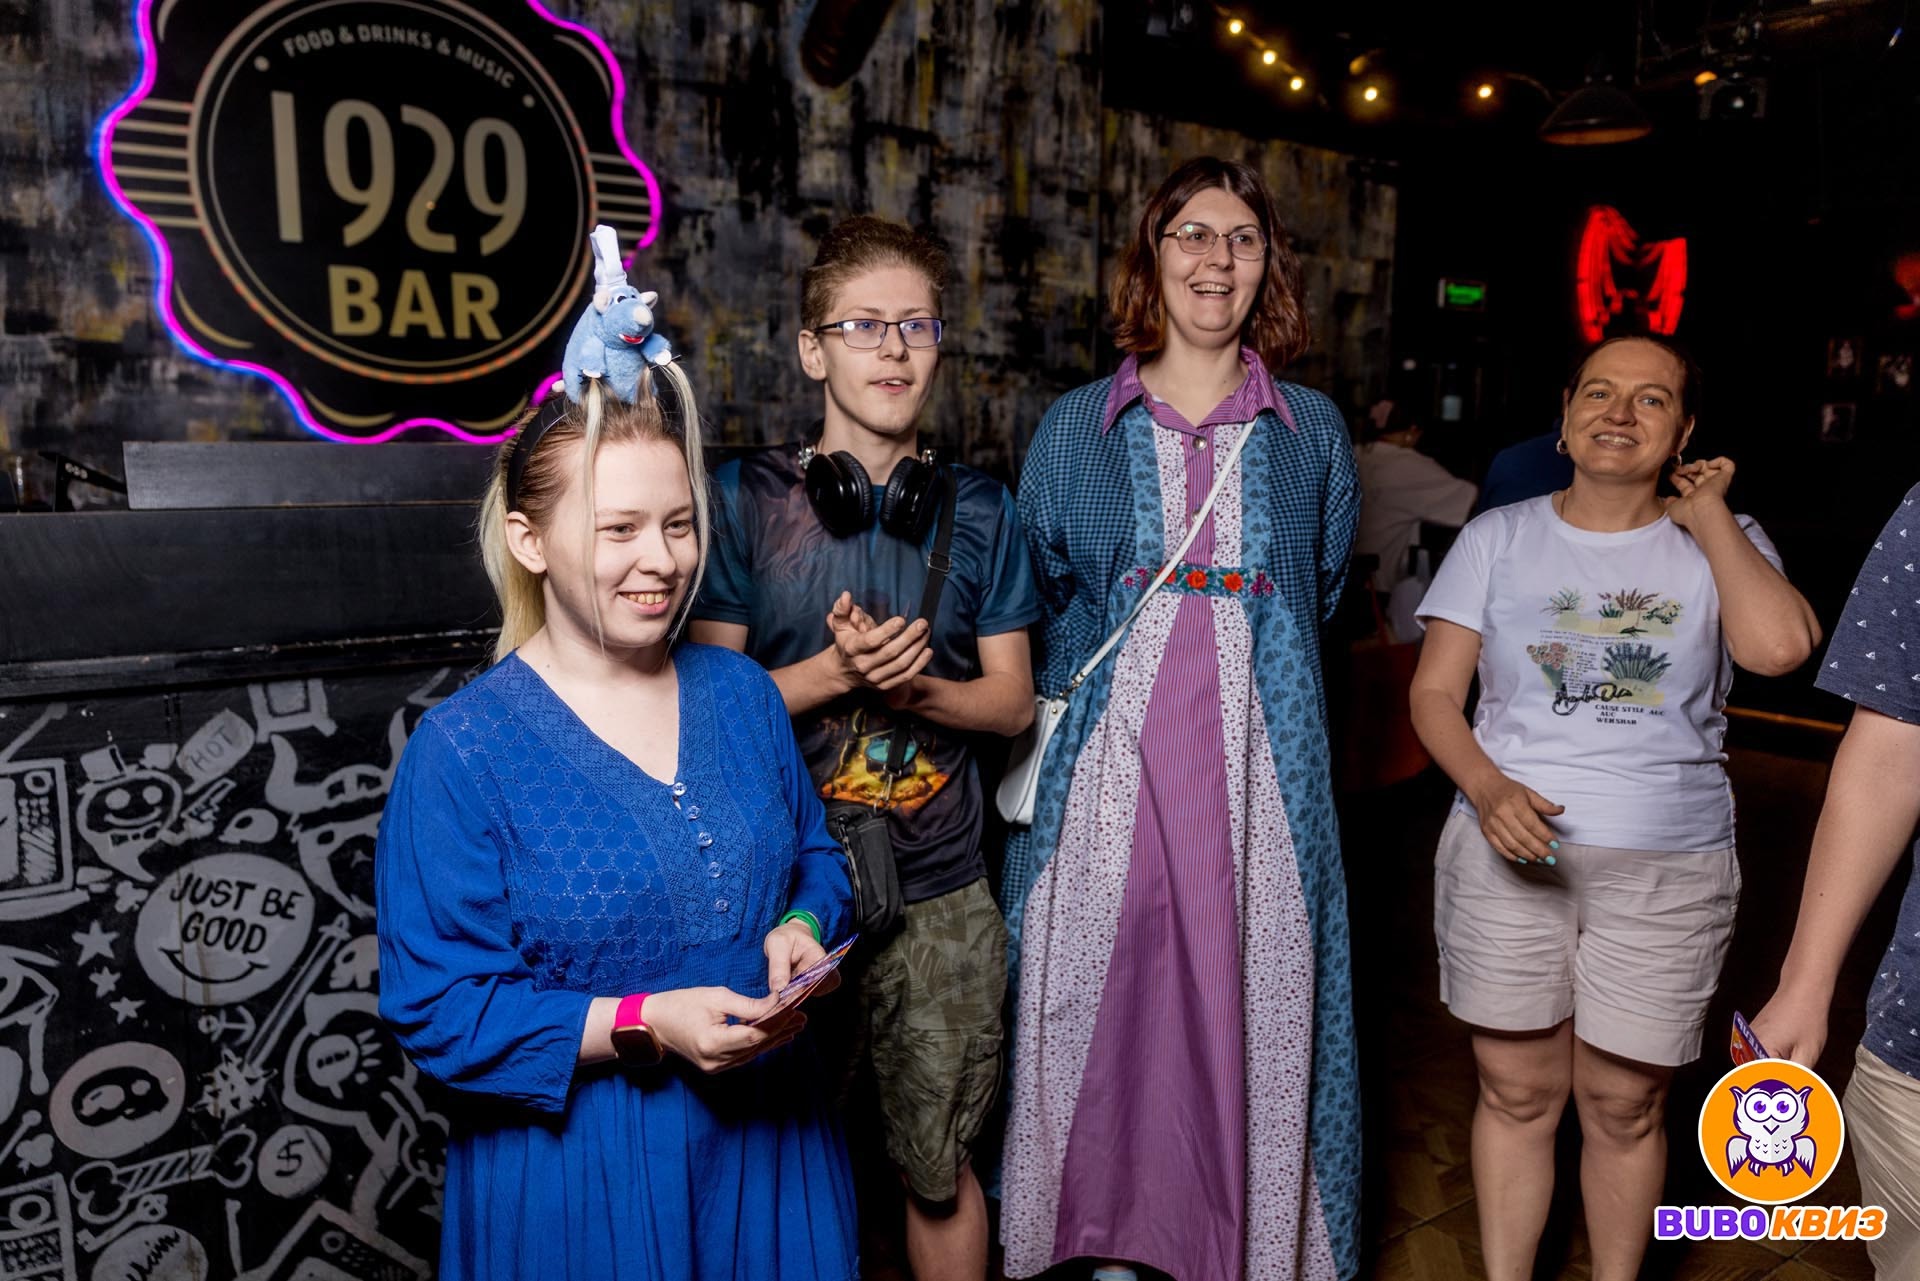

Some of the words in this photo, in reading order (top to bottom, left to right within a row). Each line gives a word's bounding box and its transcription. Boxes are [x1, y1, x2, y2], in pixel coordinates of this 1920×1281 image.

[283, 28, 335, 58] FOOD
[339, 25, 355, 45] &
[357, 24, 432, 50] DRINKS
[437, 37, 451, 56] &
[455, 44, 515, 88] MUSIC
[271, 90, 527, 256] 1929
[328, 264, 502, 340] BAR
[190, 724, 233, 773] HOT
[169, 873, 257, 911] JUST
[260, 887, 304, 920] BE
[181, 911, 267, 955] GOOD
